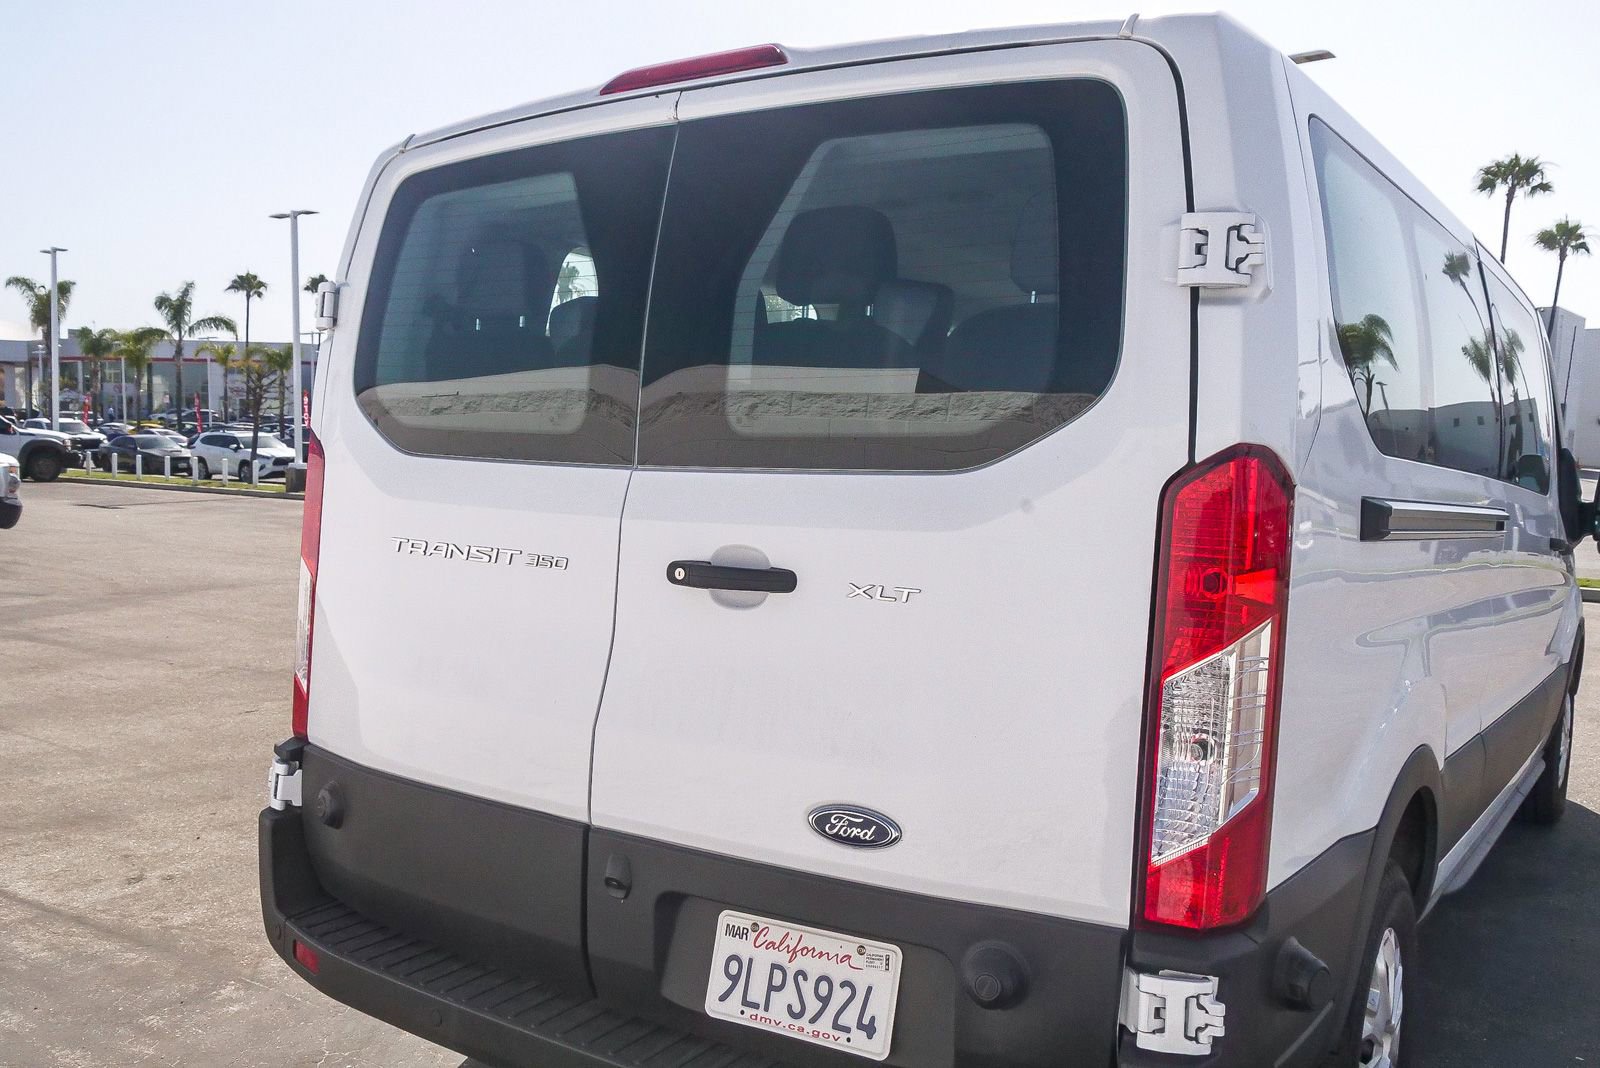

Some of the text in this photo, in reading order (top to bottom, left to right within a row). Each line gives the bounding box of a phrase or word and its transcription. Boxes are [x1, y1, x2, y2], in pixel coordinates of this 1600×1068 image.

[391, 536, 569, 571] TRANSIT 350
[848, 582, 922, 604] XLT
[825, 813, 877, 841] Ford
[725, 923, 749, 941] MAR
[752, 926, 864, 971] California
[718, 954, 877, 1040] 9LPS924
[749, 1012, 841, 1042] dmv.ca.gov
